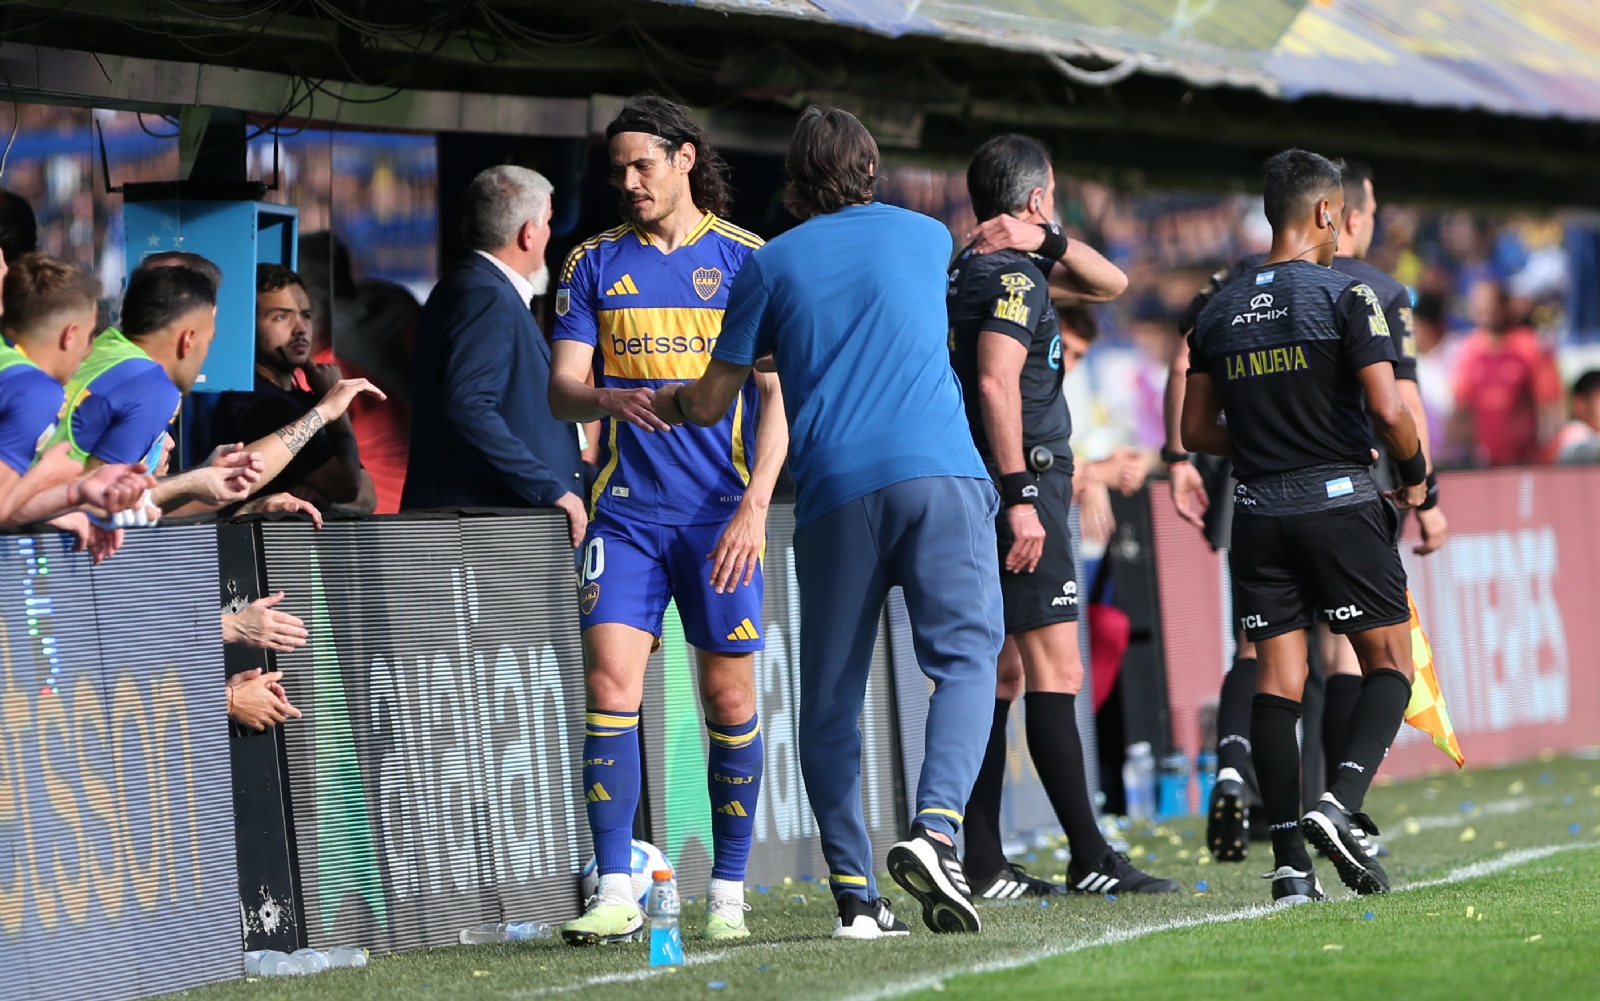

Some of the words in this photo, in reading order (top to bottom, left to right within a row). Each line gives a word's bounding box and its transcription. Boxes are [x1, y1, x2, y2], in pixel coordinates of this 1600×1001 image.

[695, 278, 718, 286] CABJ
[1009, 290, 1024, 306] LA
[994, 298, 1031, 328] NUEVA
[1231, 306, 1288, 326] ATHIX
[1226, 354, 1247, 380] LA
[1249, 346, 1308, 376] NUEVA
[1324, 604, 1364, 621] TCL
[1241, 614, 1269, 631] TCL
[714, 772, 754, 785] CABJ
